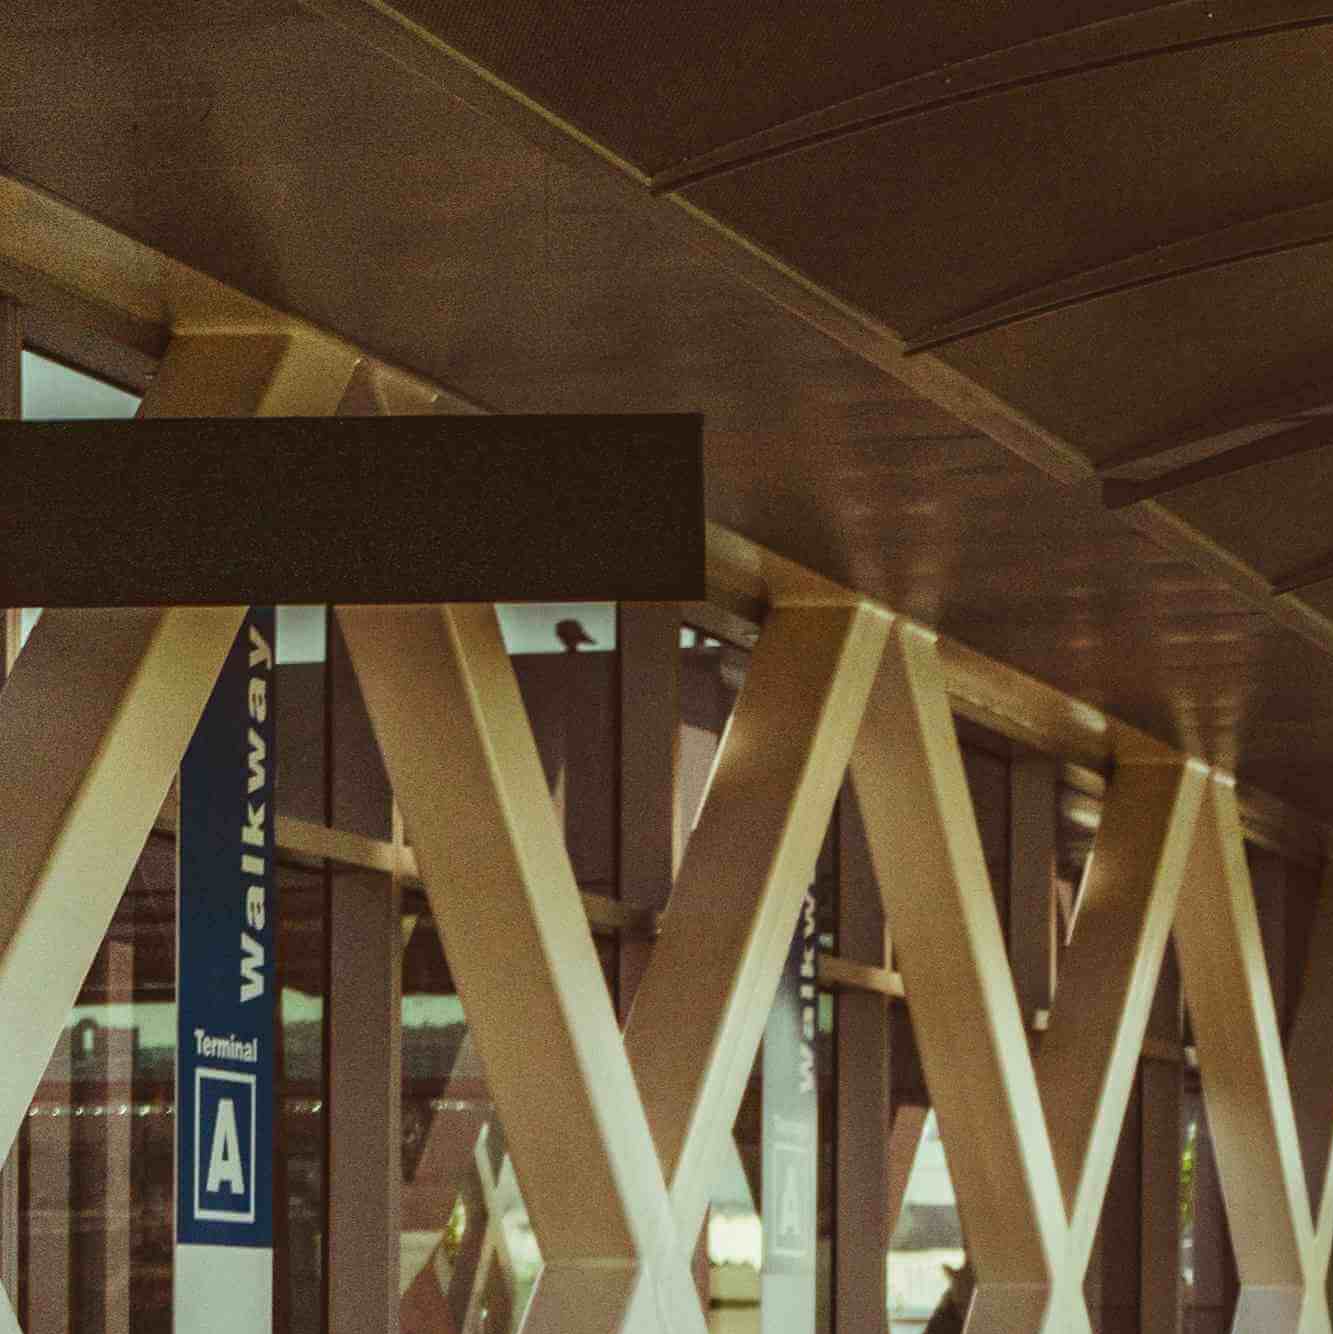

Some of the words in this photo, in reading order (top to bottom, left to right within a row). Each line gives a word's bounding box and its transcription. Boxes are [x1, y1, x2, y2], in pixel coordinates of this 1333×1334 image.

[239, 625, 271, 1003] walkway
[194, 1027, 258, 1063] Terminal
[206, 1098, 245, 1195] A
